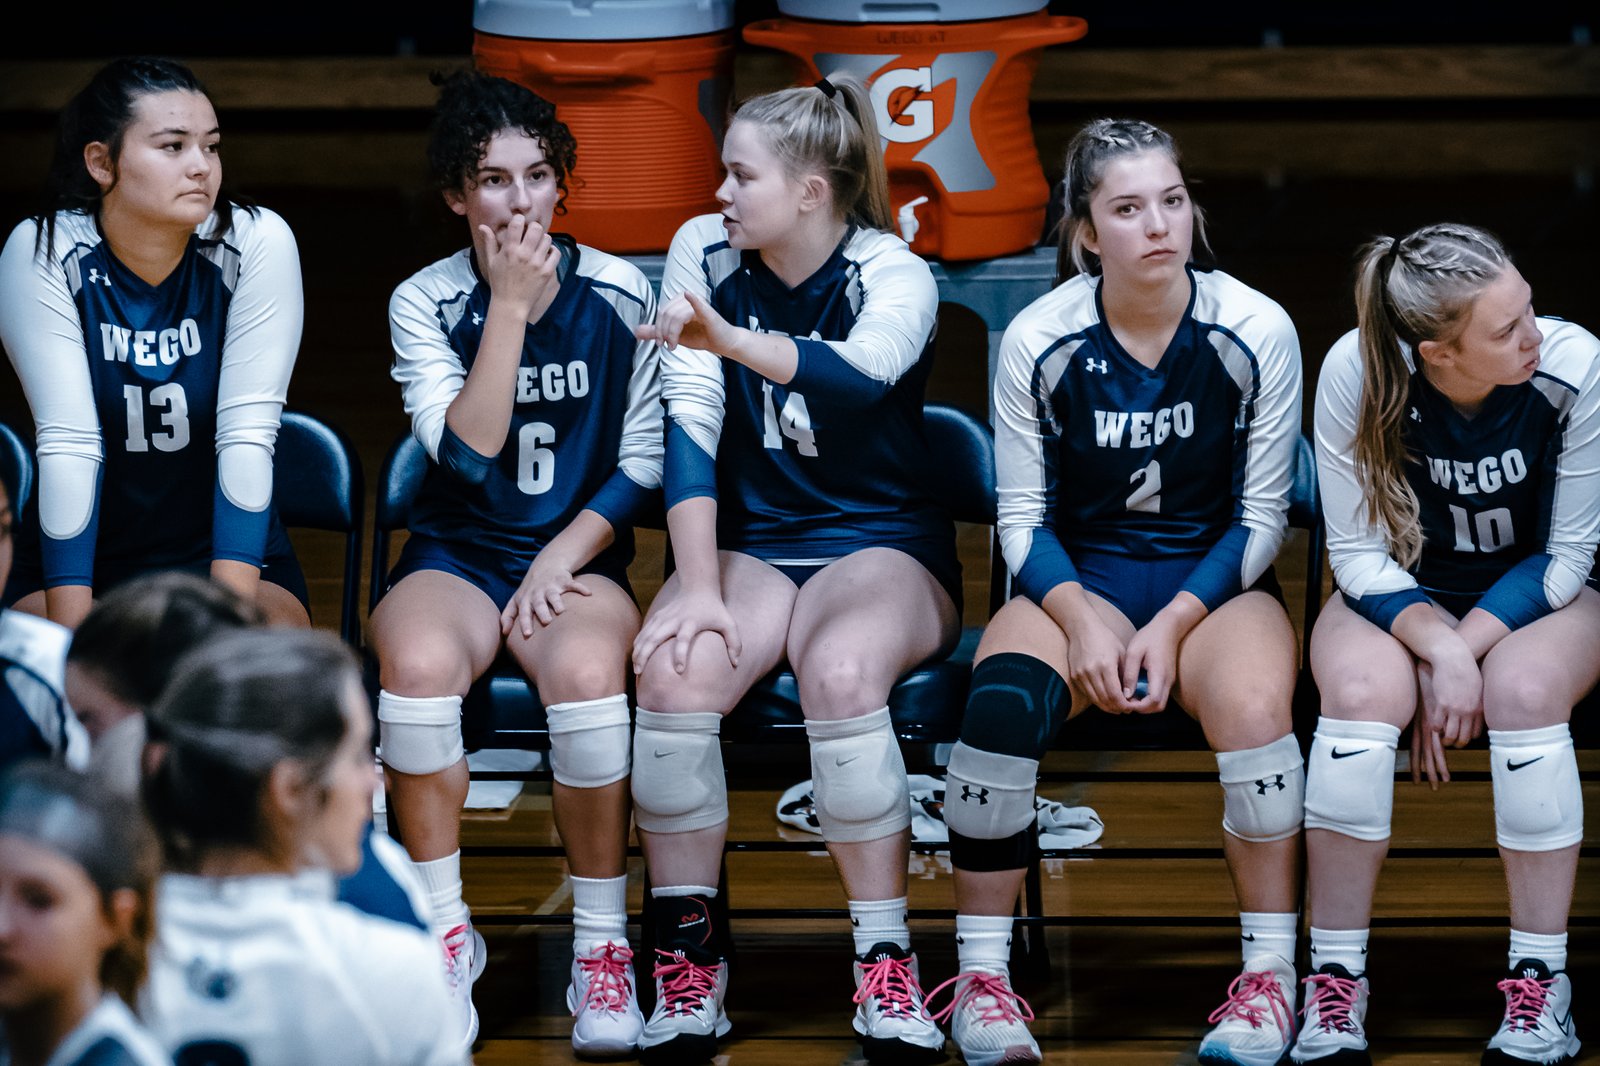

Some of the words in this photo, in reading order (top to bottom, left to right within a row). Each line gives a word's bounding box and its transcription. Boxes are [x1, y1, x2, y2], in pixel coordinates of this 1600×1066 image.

[869, 66, 935, 143] G
[100, 318, 202, 366] WEGO
[516, 360, 590, 402] EGO
[123, 382, 191, 452] 13
[761, 379, 819, 457] 14
[1094, 401, 1194, 448] WEGO
[517, 421, 556, 495] 6
[1425, 448, 1528, 495] WEGO
[1126, 459, 1162, 513] 2
[1448, 504, 1515, 553] 10
